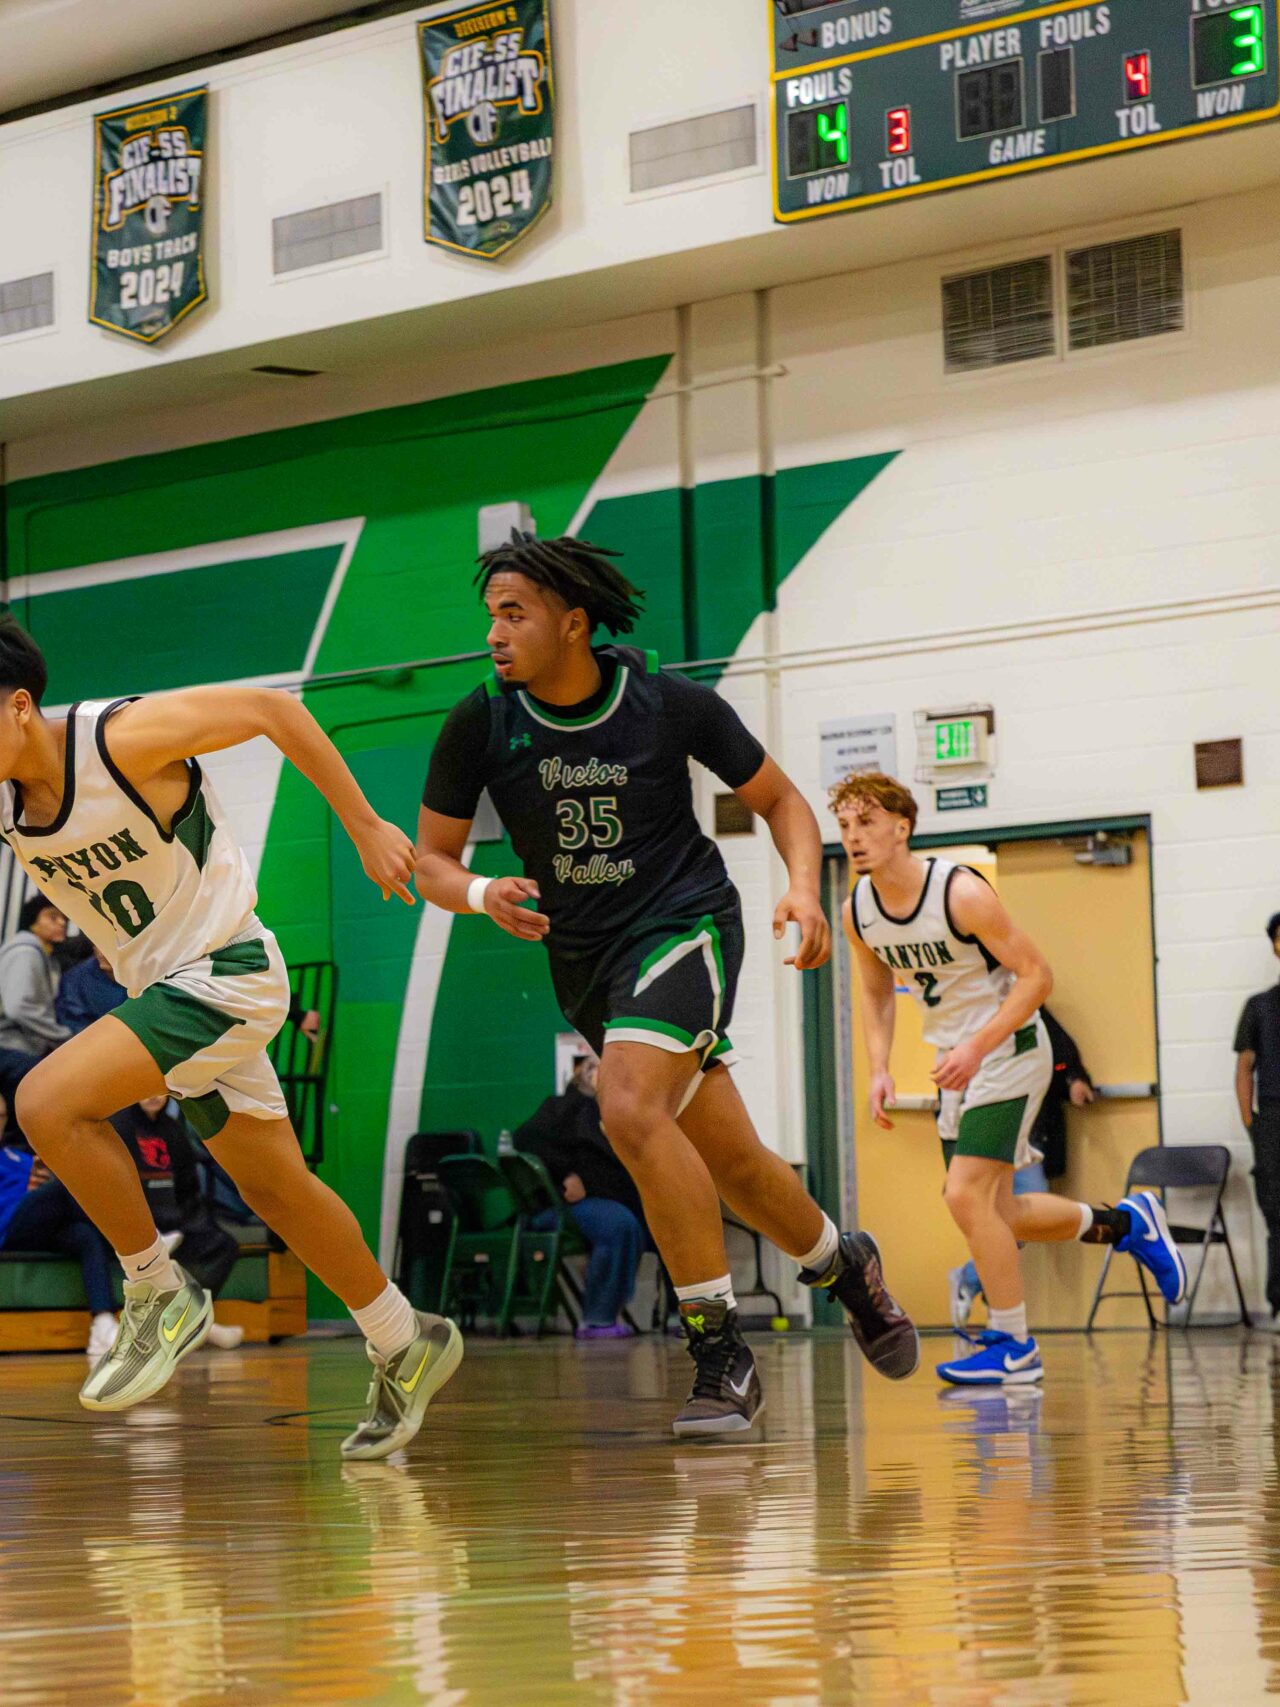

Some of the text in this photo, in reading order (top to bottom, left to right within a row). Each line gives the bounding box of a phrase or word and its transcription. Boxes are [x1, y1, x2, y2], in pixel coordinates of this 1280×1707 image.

[822, 7, 892, 48] BONUS
[940, 28, 1021, 71] PLAYER
[1040, 6, 1110, 48] FOULS
[1230, 5, 1264, 75] 3
[446, 31, 521, 77] CIF-SS
[787, 68, 852, 107] FOULS
[1126, 53, 1149, 97] 4
[430, 57, 539, 137] FINALIST
[1197, 86, 1245, 118] WON
[817, 103, 848, 163] 4
[887, 108, 910, 154] 3
[1116, 104, 1161, 137] TOL
[123, 130, 186, 170] CIF-SS
[989, 129, 1045, 165] GAME
[108, 156, 202, 226] FINALIST
[807, 173, 849, 204] WON
[879, 156, 921, 188] TOL
[456, 169, 532, 227] 2024
[107, 246, 152, 269] BOYS
[120, 261, 185, 310] 2024
[936, 720, 973, 760] EXIT
[538, 756, 628, 790] Victor
[555, 796, 623, 850] 35
[552, 853, 635, 886] Valley
[914, 971, 941, 1007] 2
